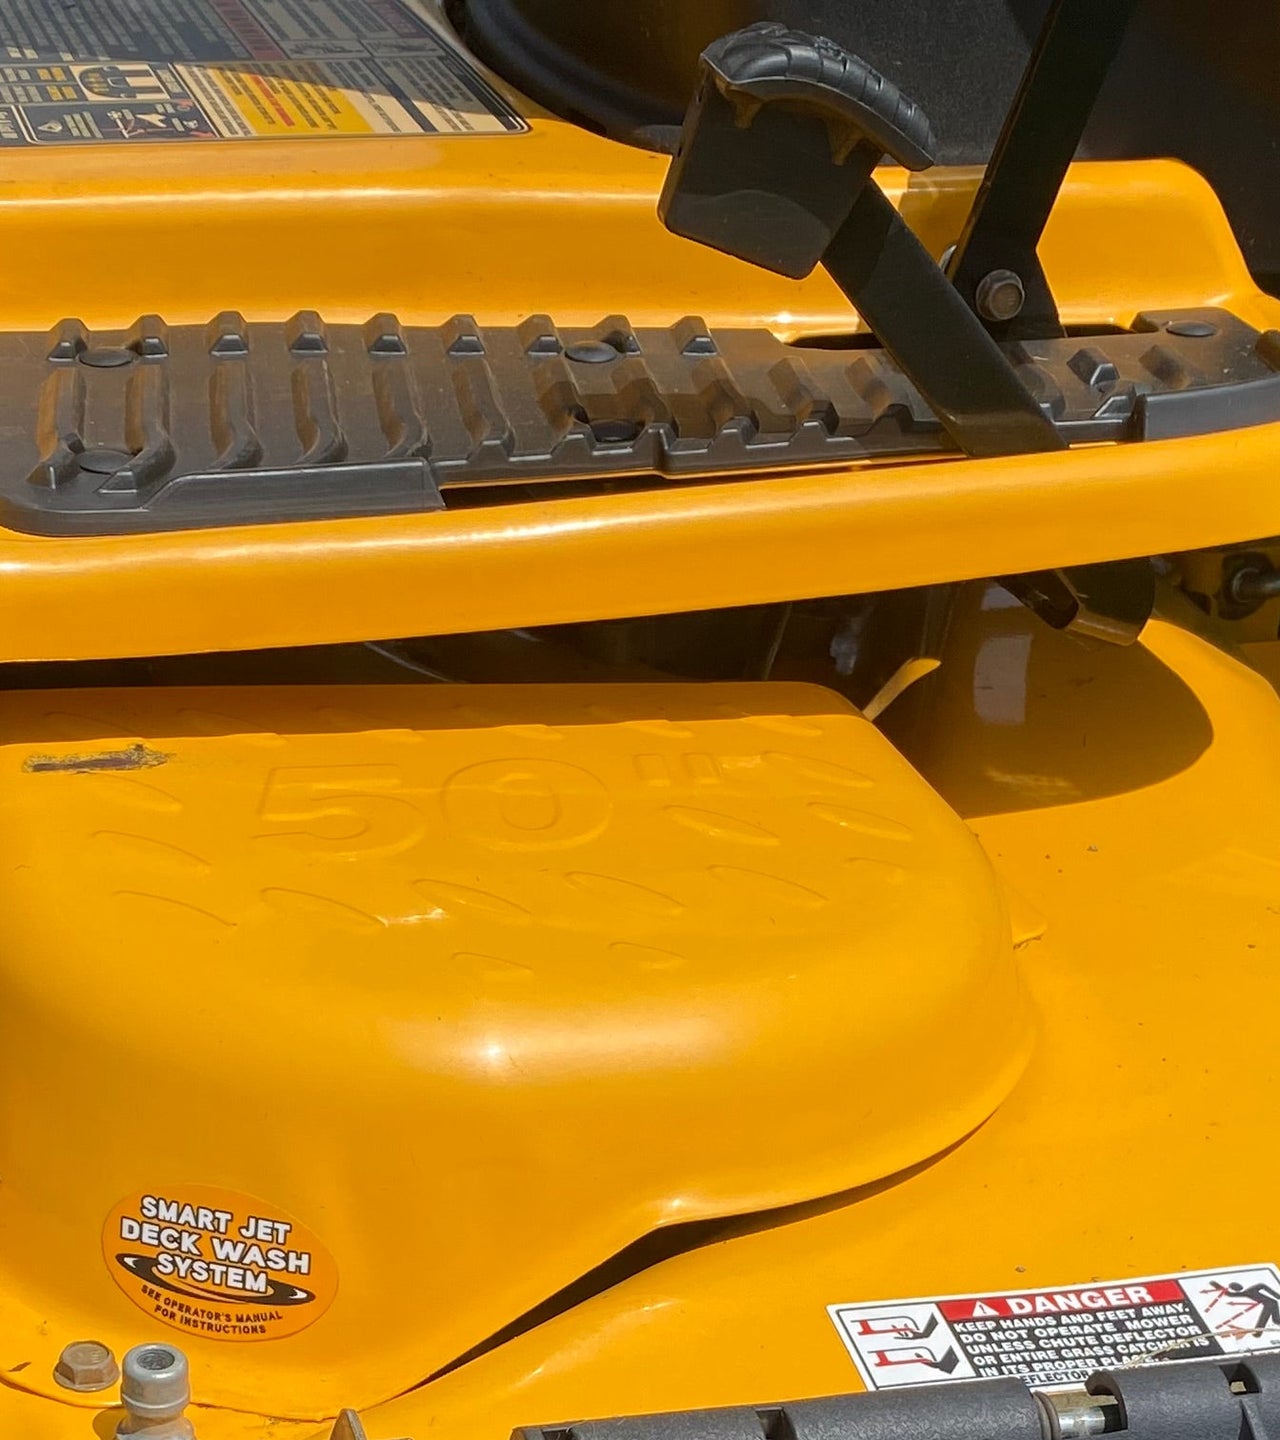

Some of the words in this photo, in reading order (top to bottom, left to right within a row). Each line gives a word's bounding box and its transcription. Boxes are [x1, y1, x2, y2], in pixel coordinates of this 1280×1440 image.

[140, 1195, 232, 1233] SMART
[239, 1215, 291, 1244] JET
[120, 1217, 201, 1255] DECK
[212, 1237, 310, 1274] WASH
[156, 1253, 268, 1293] SYSTEM
[141, 1284, 161, 1301] SEE
[164, 1298, 231, 1322] OPERATOR'S
[236, 1310, 283, 1323] MANUAL
[1006, 1286, 1153, 1315] DANGER
[154, 1304, 176, 1320] FOR
[180, 1315, 266, 1334] INSTRUCTIONS
[953, 1321, 997, 1333] KEEP
[1001, 1316, 1057, 1329] HANDS
[1061, 1311, 1095, 1325] AND
[1096, 1308, 1137, 1321] FEET
[1142, 1303, 1190, 1318] AWAY.
[960, 1333, 987, 1343] DO
[991, 1329, 1029, 1341] NOT
[1034, 1322, 1117, 1338] OPERATE
[1126, 1314, 1194, 1331] MOWER
[967, 1339, 1036, 1355] UNLESS
[1039, 1334, 1098, 1348] CHUTE
[1102, 1325, 1202, 1344] DEFLECTOR
[972, 1355, 997, 1366] OR
[1000, 1349, 1059, 1363] ENTIRE
[1061, 1345, 1114, 1358] GRASS
[1193, 1337, 1210, 1347] IS
[979, 1367, 998, 1377] IN
[1002, 1364, 1030, 1375] ITS
[1033, 1358, 1098, 1371] PROPER
[1020, 1370, 1090, 1386] EFLECTOR
